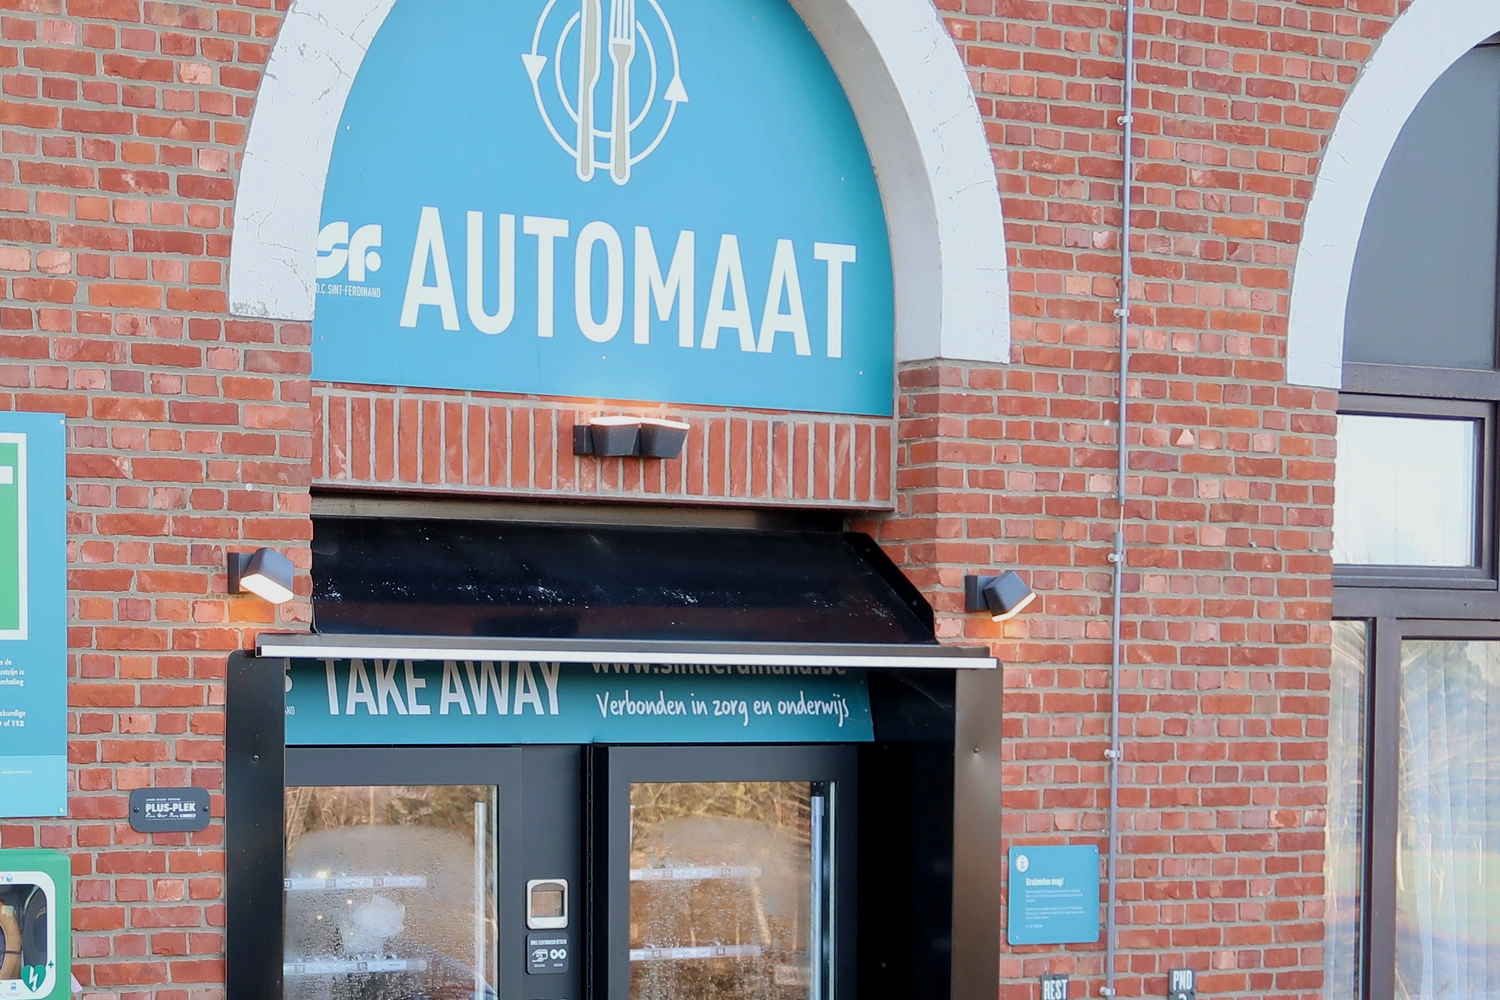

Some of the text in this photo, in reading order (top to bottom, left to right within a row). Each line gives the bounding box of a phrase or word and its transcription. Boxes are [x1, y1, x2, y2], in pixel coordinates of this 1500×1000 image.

[399, 206, 857, 359] AUTOMAAT
[317, 658, 560, 715] TAKE AWAY
[596, 689, 850, 728] Verbonden in zorg en onderwijs
[145, 803, 196, 813] PLUS-PLEK
[1043, 979, 1068, 1000] REST
[1172, 970, 1193, 991] PMD
